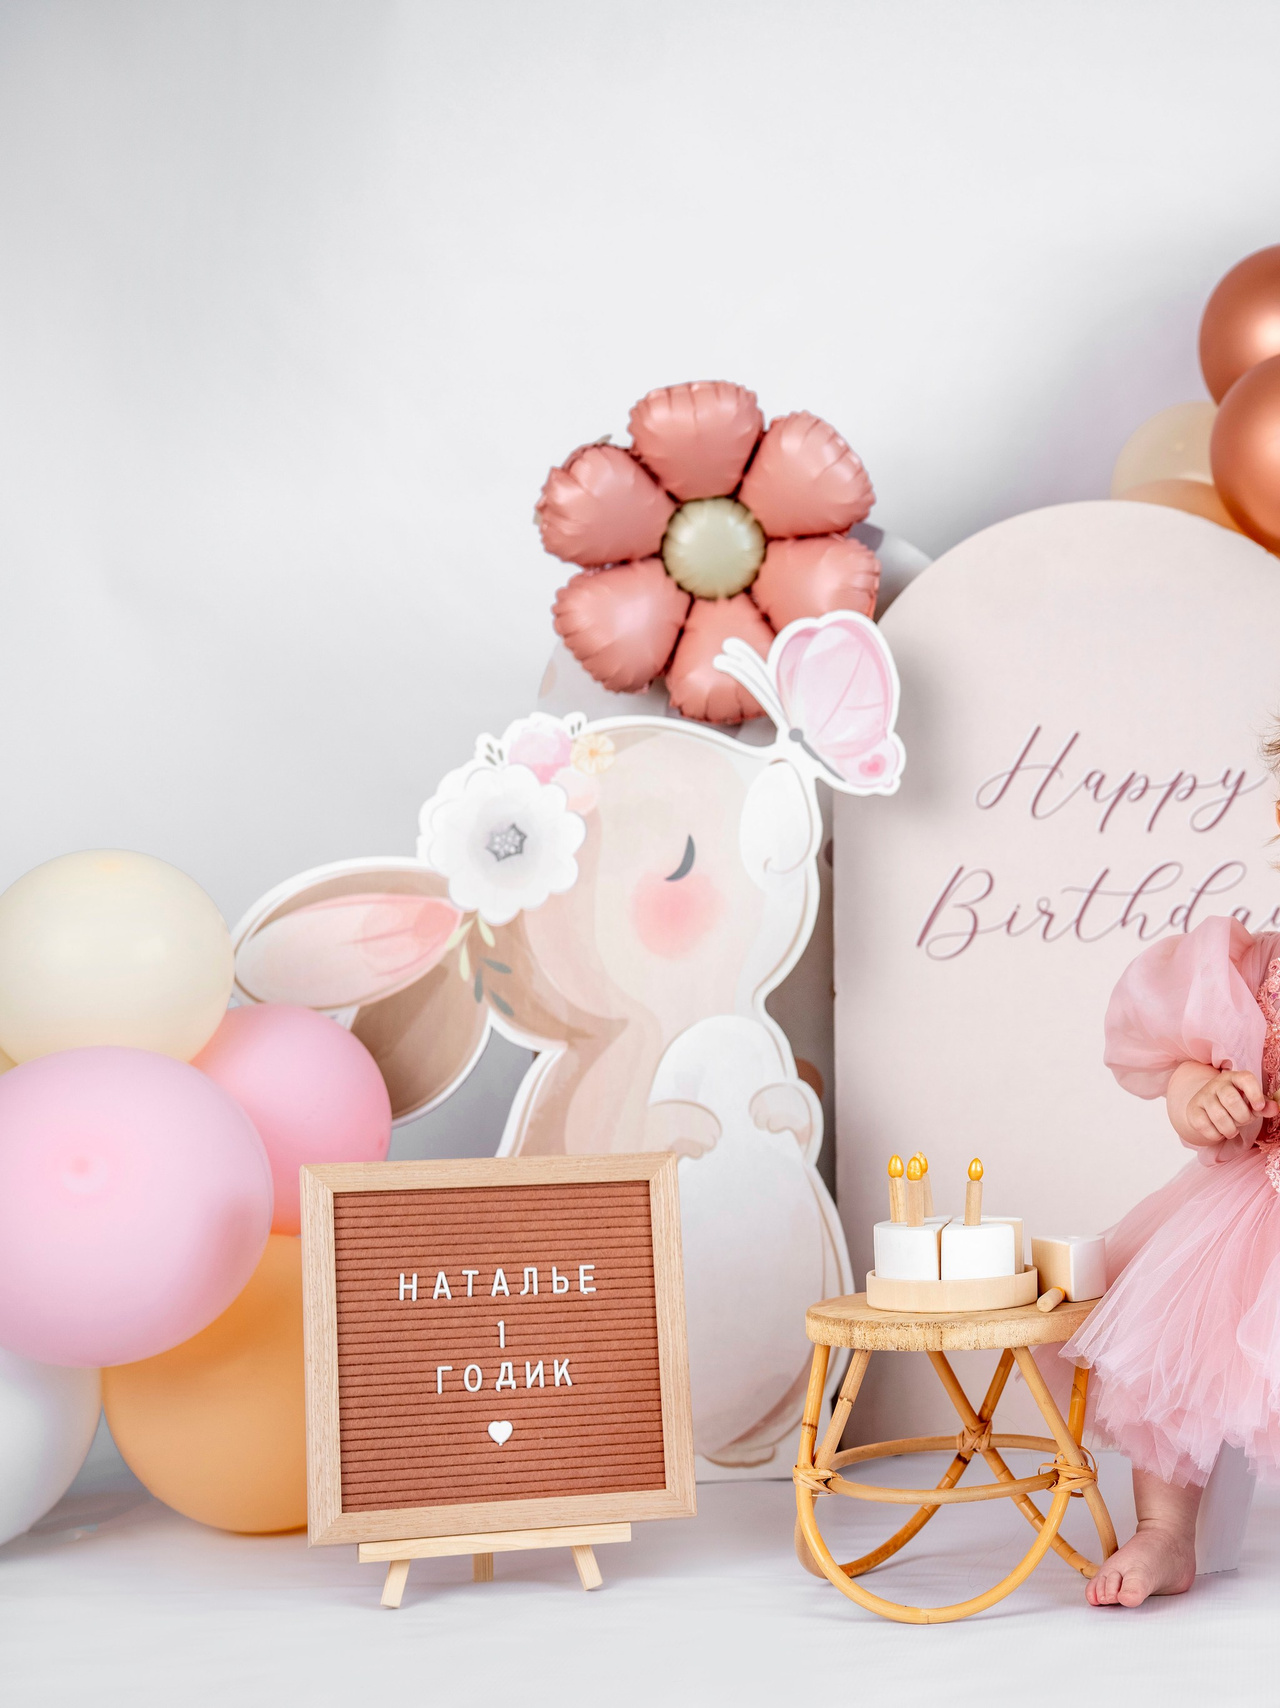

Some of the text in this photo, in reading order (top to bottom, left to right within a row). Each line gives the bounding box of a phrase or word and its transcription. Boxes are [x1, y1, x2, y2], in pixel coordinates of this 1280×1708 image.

[976, 724, 1268, 834] Happy
[398, 1263, 597, 1302] НАТАЛЬЕ
[496, 1320, 506, 1349] 1
[436, 1357, 574, 1395] ГОДИК
